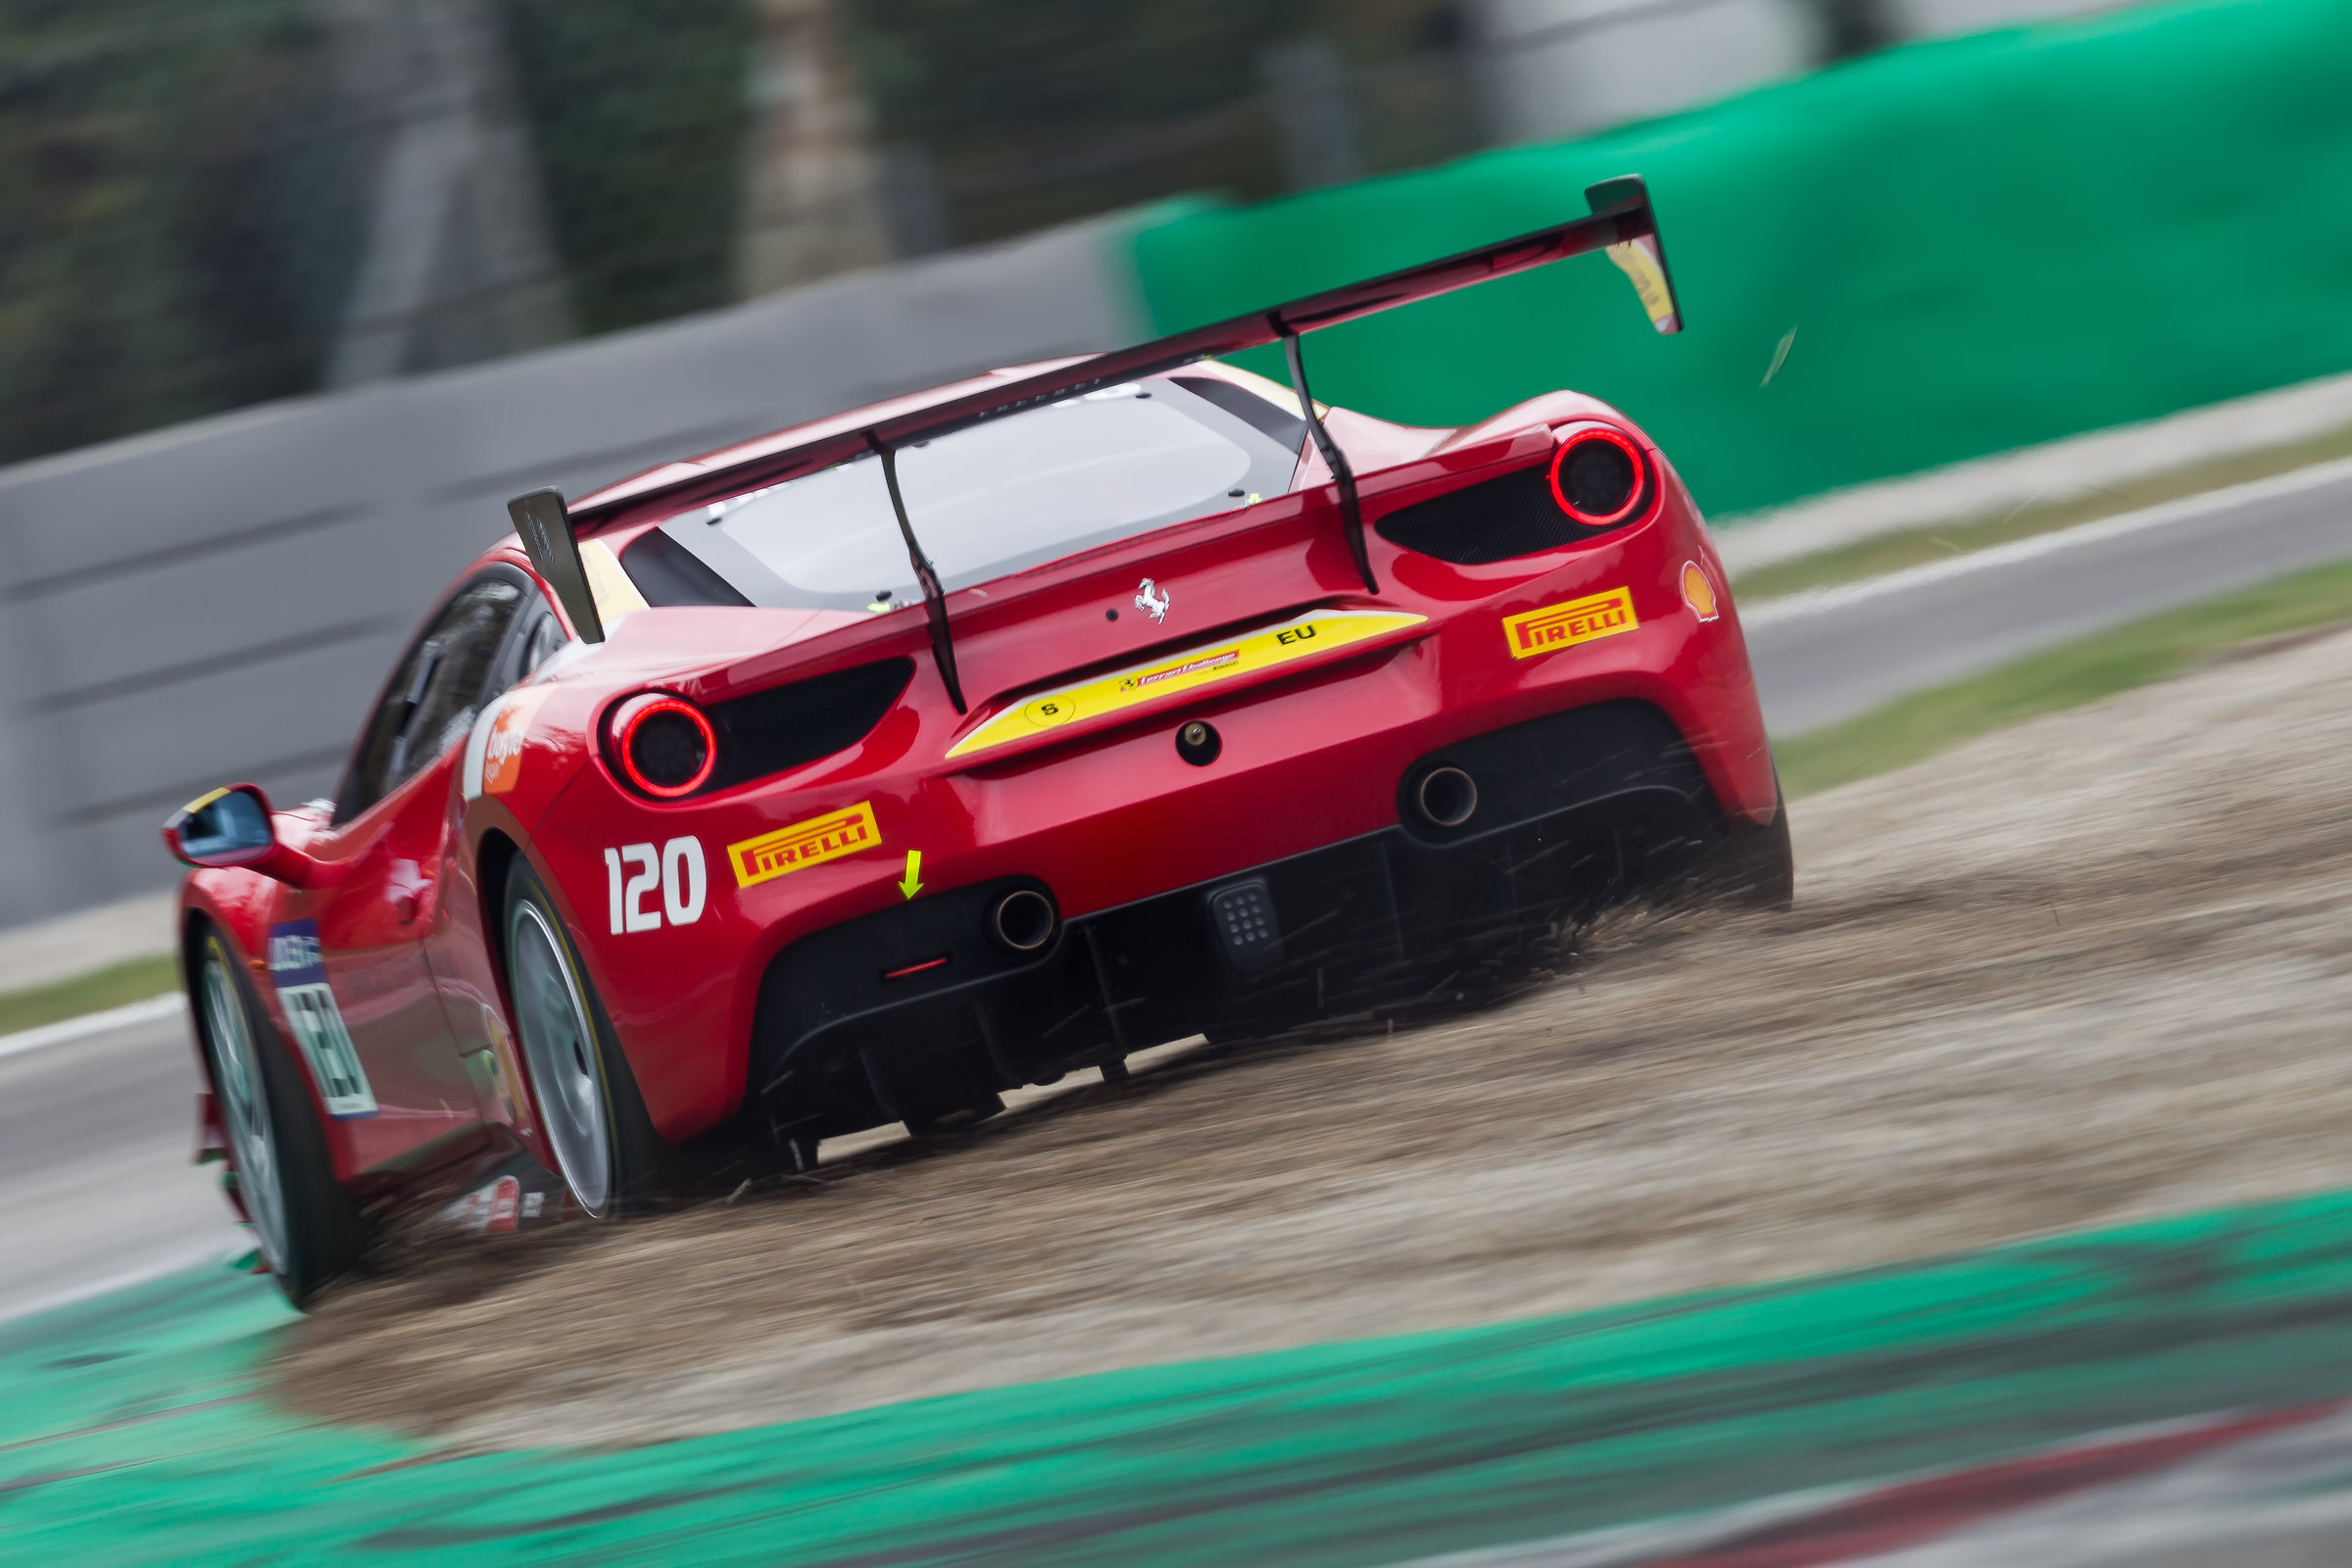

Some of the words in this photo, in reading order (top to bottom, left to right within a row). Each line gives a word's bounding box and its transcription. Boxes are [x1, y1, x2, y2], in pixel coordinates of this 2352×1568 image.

[1277, 625, 1316, 645] EU
[1515, 597, 1627, 650] PIRELLI
[740, 812, 868, 877] PIRELLI
[604, 835, 707, 935] 120
